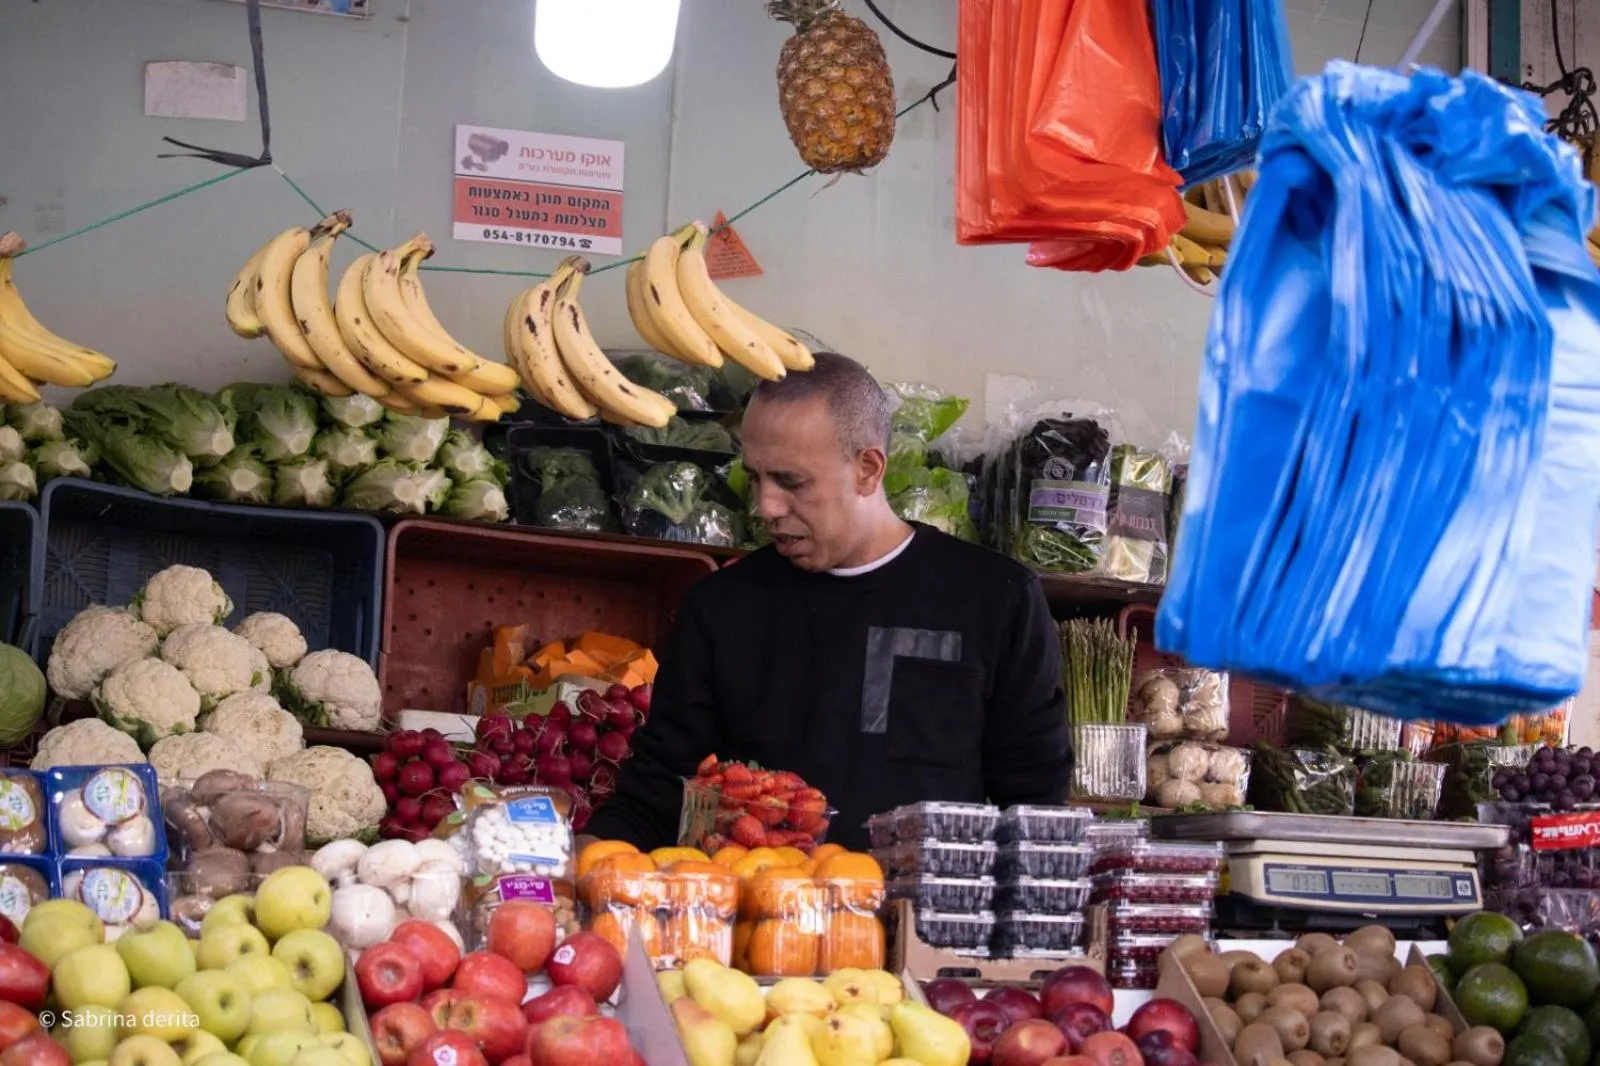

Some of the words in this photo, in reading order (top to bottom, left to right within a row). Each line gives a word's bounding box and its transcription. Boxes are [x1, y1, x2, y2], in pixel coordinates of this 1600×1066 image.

[519, 145, 576, 162] מערכות
[581, 153, 612, 167] אוקו
[468, 185, 530, 202] באמצעות
[535, 193, 562, 206] מוגן
[471, 205, 500, 217] סגור
[568, 195, 610, 211] המקום
[506, 206, 549, 222] במעגל
[554, 211, 607, 228] מצלמות
[483, 229, 576, 247] 054-8170794
